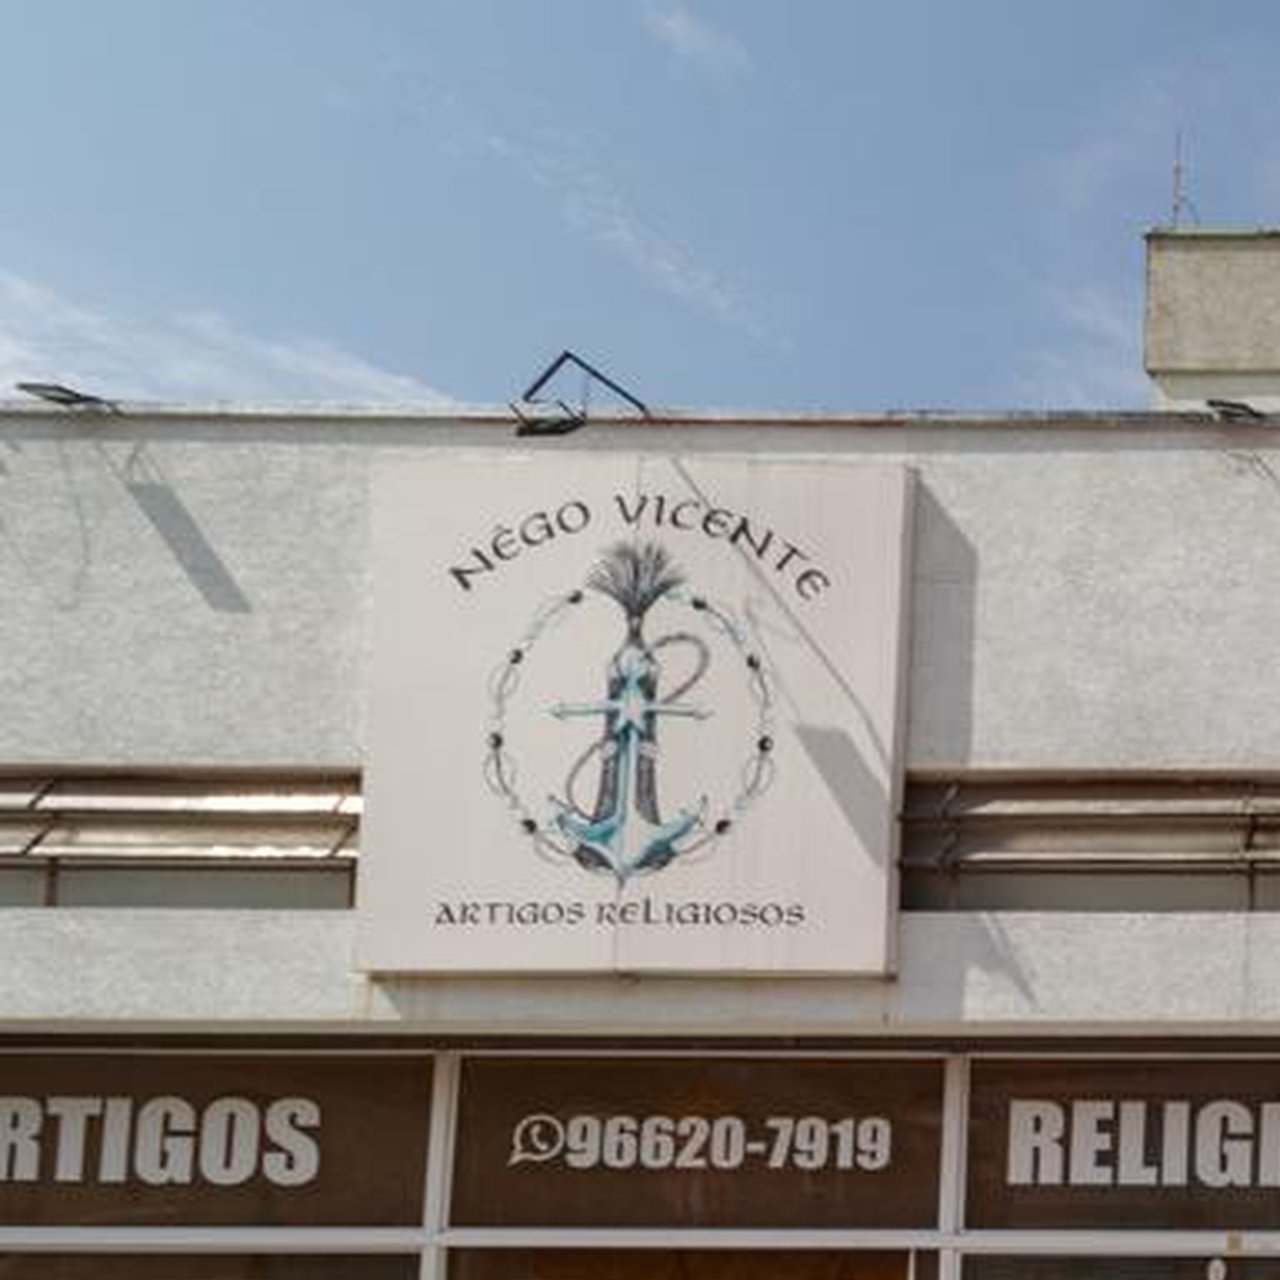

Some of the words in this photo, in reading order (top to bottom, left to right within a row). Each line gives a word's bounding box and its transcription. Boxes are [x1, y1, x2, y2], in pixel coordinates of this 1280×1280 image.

[615, 494, 831, 601] VICENTE
[435, 901, 585, 926] ARTIGOS
[597, 896, 805, 926] RELIGIOSOS
[564, 1115, 893, 1170] 96620-7919
